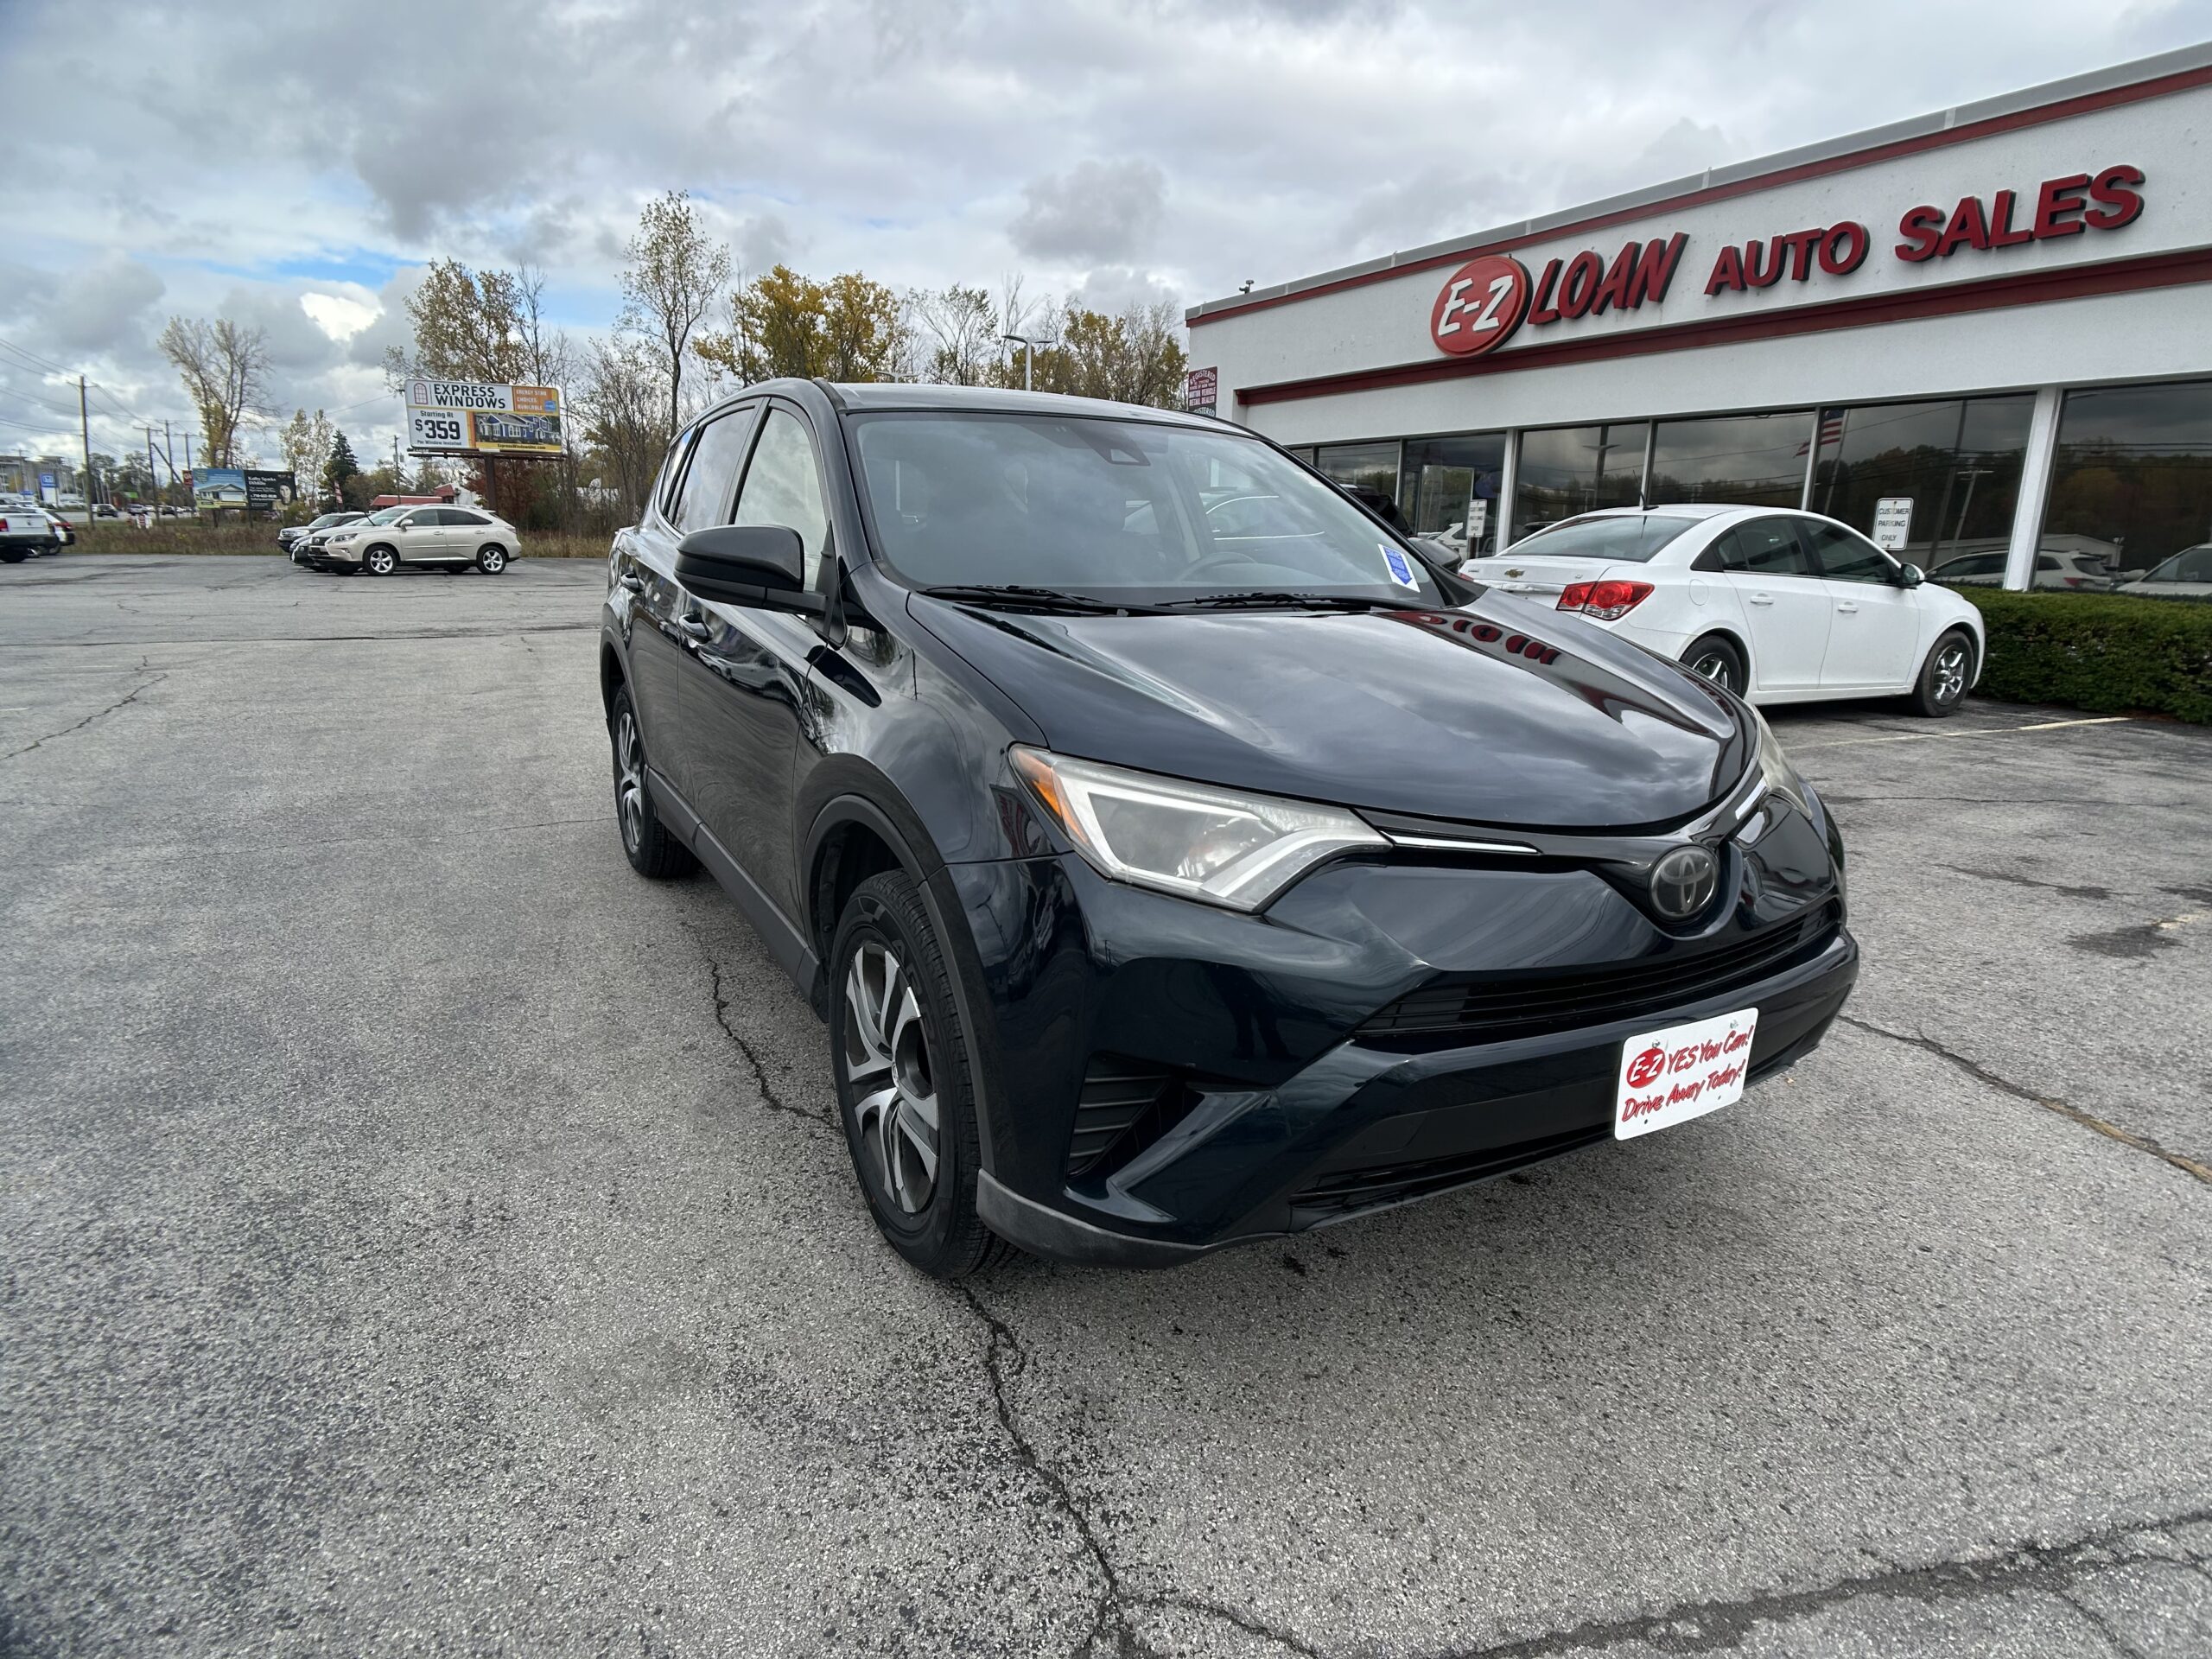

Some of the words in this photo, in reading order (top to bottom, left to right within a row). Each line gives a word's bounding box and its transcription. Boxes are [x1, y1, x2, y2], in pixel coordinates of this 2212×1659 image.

[1438, 275, 1513, 336] E-Z
[1527, 232, 1689, 325] LOAN
[1704, 220, 1871, 296] AUTO
[1895, 164, 2145, 262] SALES
[1189, 370, 1216, 385] REGISTERED
[434, 384, 495, 397] EXPRESS
[1201, 387, 1216, 396] VEHICLE
[435, 395, 506, 409] WINDOWS
[1201, 395, 1215, 404] DEALER
[415, 418, 461, 440] $359
[1630, 1053, 1663, 1083] E-Z
[1668, 1045, 1699, 1075] YES
[1699, 1039, 1722, 1063] You
[1723, 1025, 1754, 1054] Can!
[1622, 1096, 1664, 1122] Drive
[1666, 1080, 1706, 1107] Away
[1707, 1058, 1746, 1091] Today!
